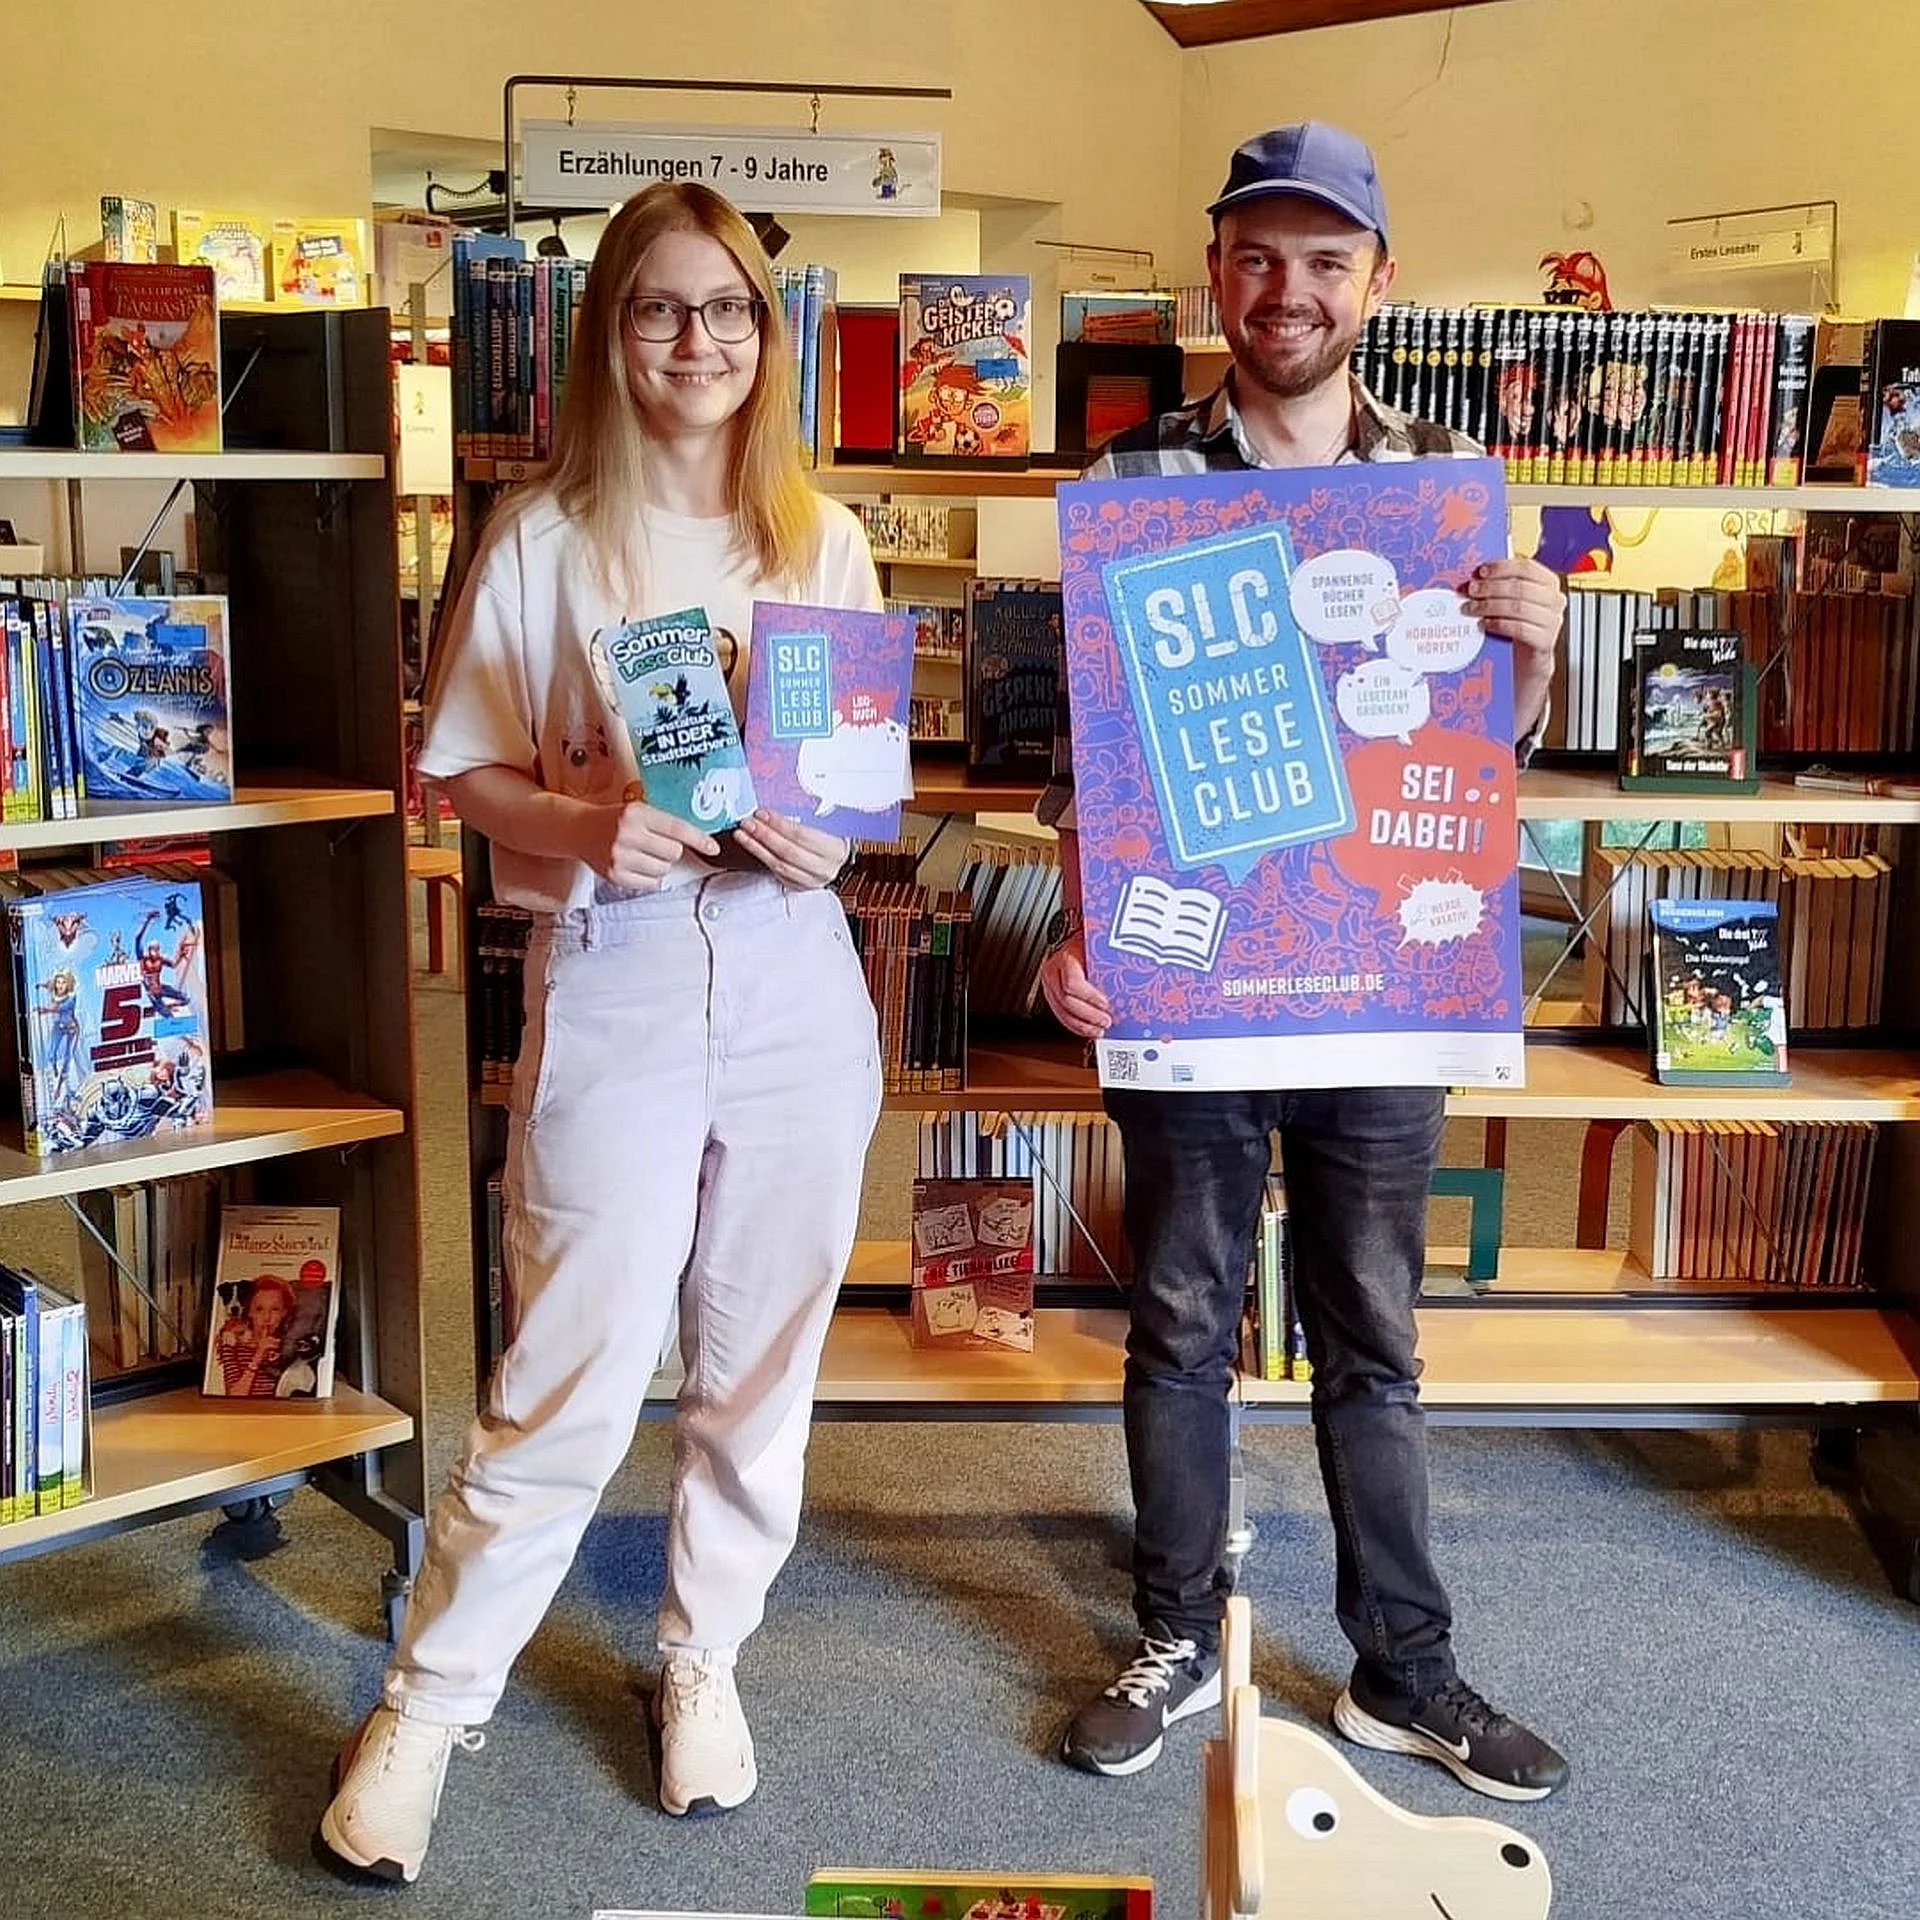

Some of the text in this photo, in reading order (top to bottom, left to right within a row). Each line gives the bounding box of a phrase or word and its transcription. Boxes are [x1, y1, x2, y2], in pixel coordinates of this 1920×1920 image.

[559, 150, 702, 181] Erzählungen
[710, 155, 723, 178] 7
[745, 157, 758, 178] 9
[765, 157, 828, 181] Jahre
[923, 300, 998, 333] GEISTER
[943, 318, 1005, 346] KICKER
[1311, 573, 1375, 588] SPANNENDE
[1322, 588, 1365, 603] BÜCHER
[1145, 569, 1278, 669] SLC
[1324, 605, 1364, 619] LESEN?
[610, 626, 711, 664] Sommer
[1405, 624, 1472, 640] HÖRBÜCHER
[777, 644, 822, 674] SLC
[1417, 640, 1460, 656] HÖREN?
[88, 657, 217, 701] OZEANIS
[618, 646, 714, 684] LeseClub
[779, 677, 822, 690] SOMMER
[1168, 662, 1289, 717] SOMMER
[781, 691, 823, 709] LESE
[781, 709, 824, 728] CLUB
[656, 723, 715, 750] IN DER
[1179, 701, 1303, 773] LESE
[1193, 760, 1315, 828] CLUB
[1401, 763, 1455, 804] SEI
[1369, 808, 1485, 855] DABEI!
[1222, 973, 1386, 998] SOMMERLESECLUB.DE
[100, 983, 143, 1042] 5
